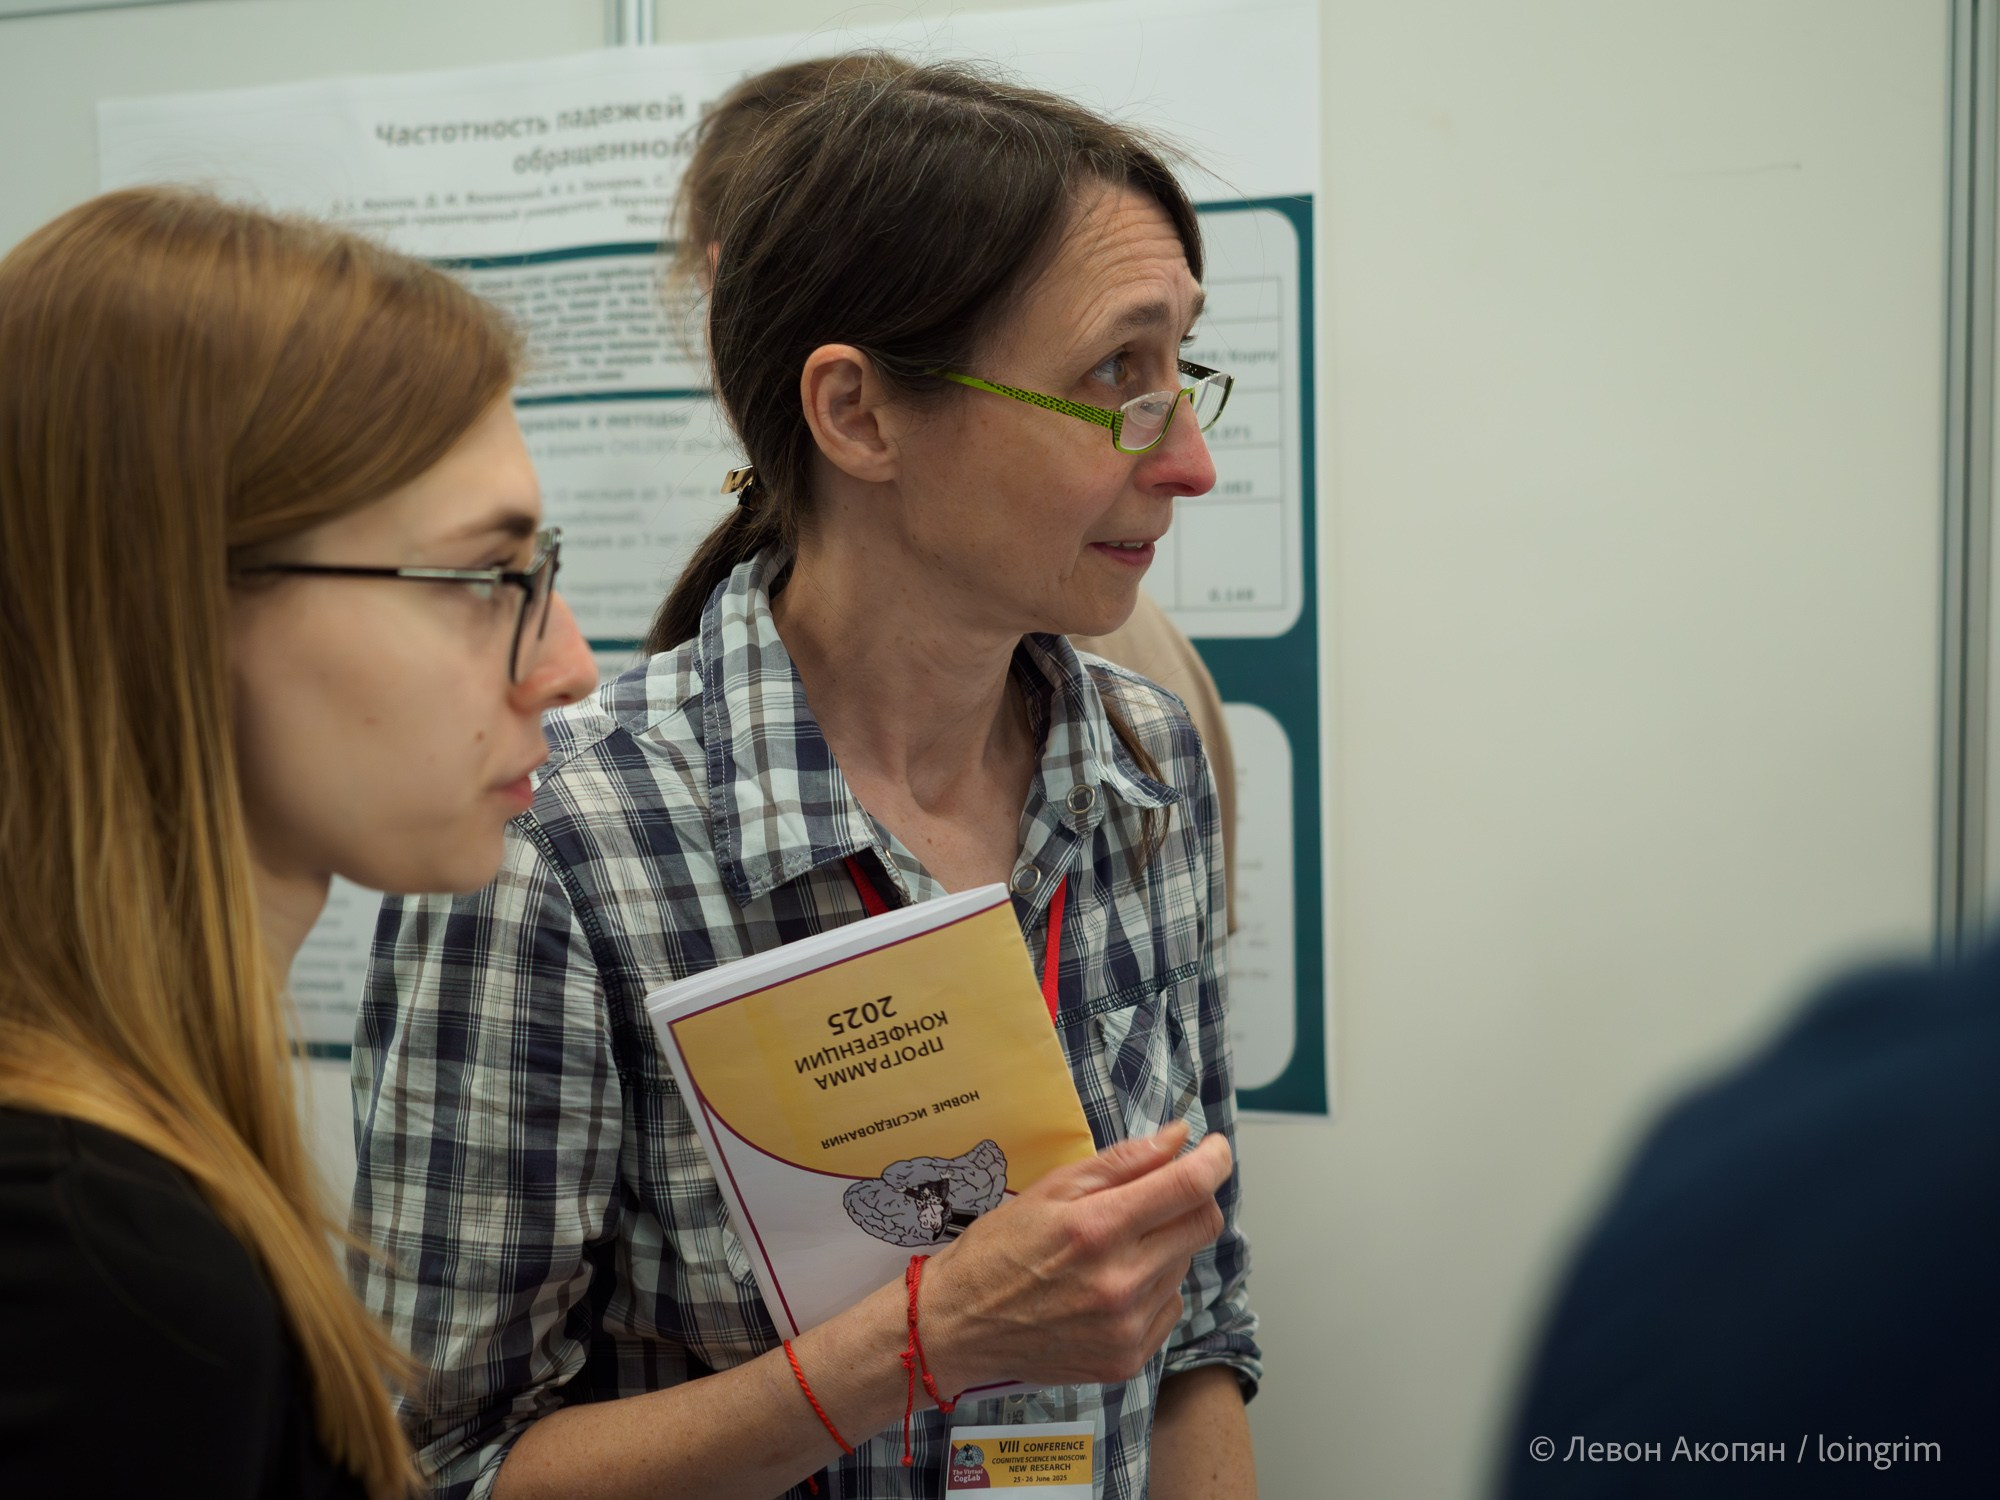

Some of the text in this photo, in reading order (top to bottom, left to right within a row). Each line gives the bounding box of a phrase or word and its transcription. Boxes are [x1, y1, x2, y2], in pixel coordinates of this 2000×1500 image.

[375, 117, 550, 147] Частотность
[827, 995, 897, 1036] 2025
[794, 1010, 949, 1074] КОНФЕРЕНЦИИ
[813, 1036, 945, 1090] ПРОГРАММА
[821, 1090, 981, 1150] НОВЫЕ ИССЛЕДОВАНИЯ
[991, 1457, 1024, 1465] COGNITIVE
[999, 1440, 1085, 1454] VIII CONFERENCE
[953, 1474, 981, 1484] CogLab
[1008, 1463, 1071, 1473] NEW RESEARCH
